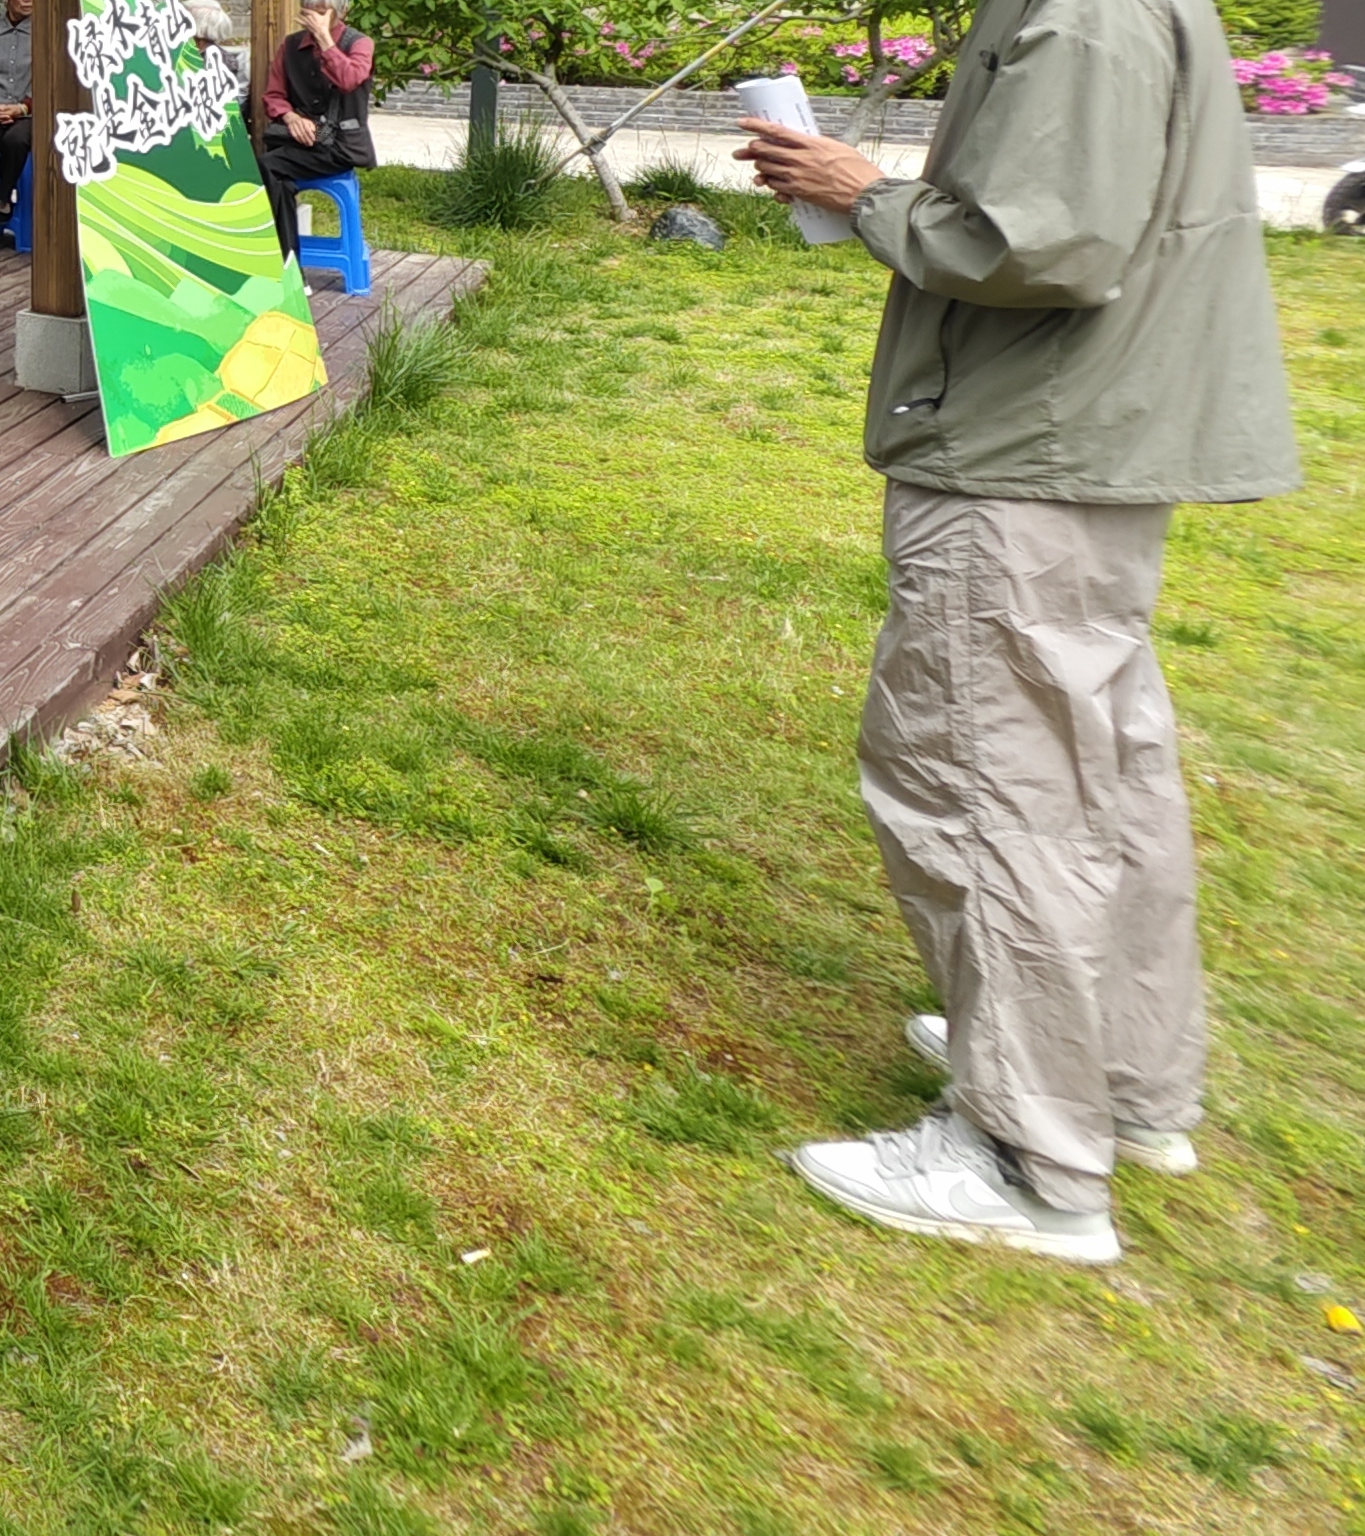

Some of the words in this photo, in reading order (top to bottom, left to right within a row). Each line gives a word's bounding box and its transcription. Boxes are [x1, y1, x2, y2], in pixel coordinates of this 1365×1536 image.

[62, 52, 236, 177] 就是金山银山
